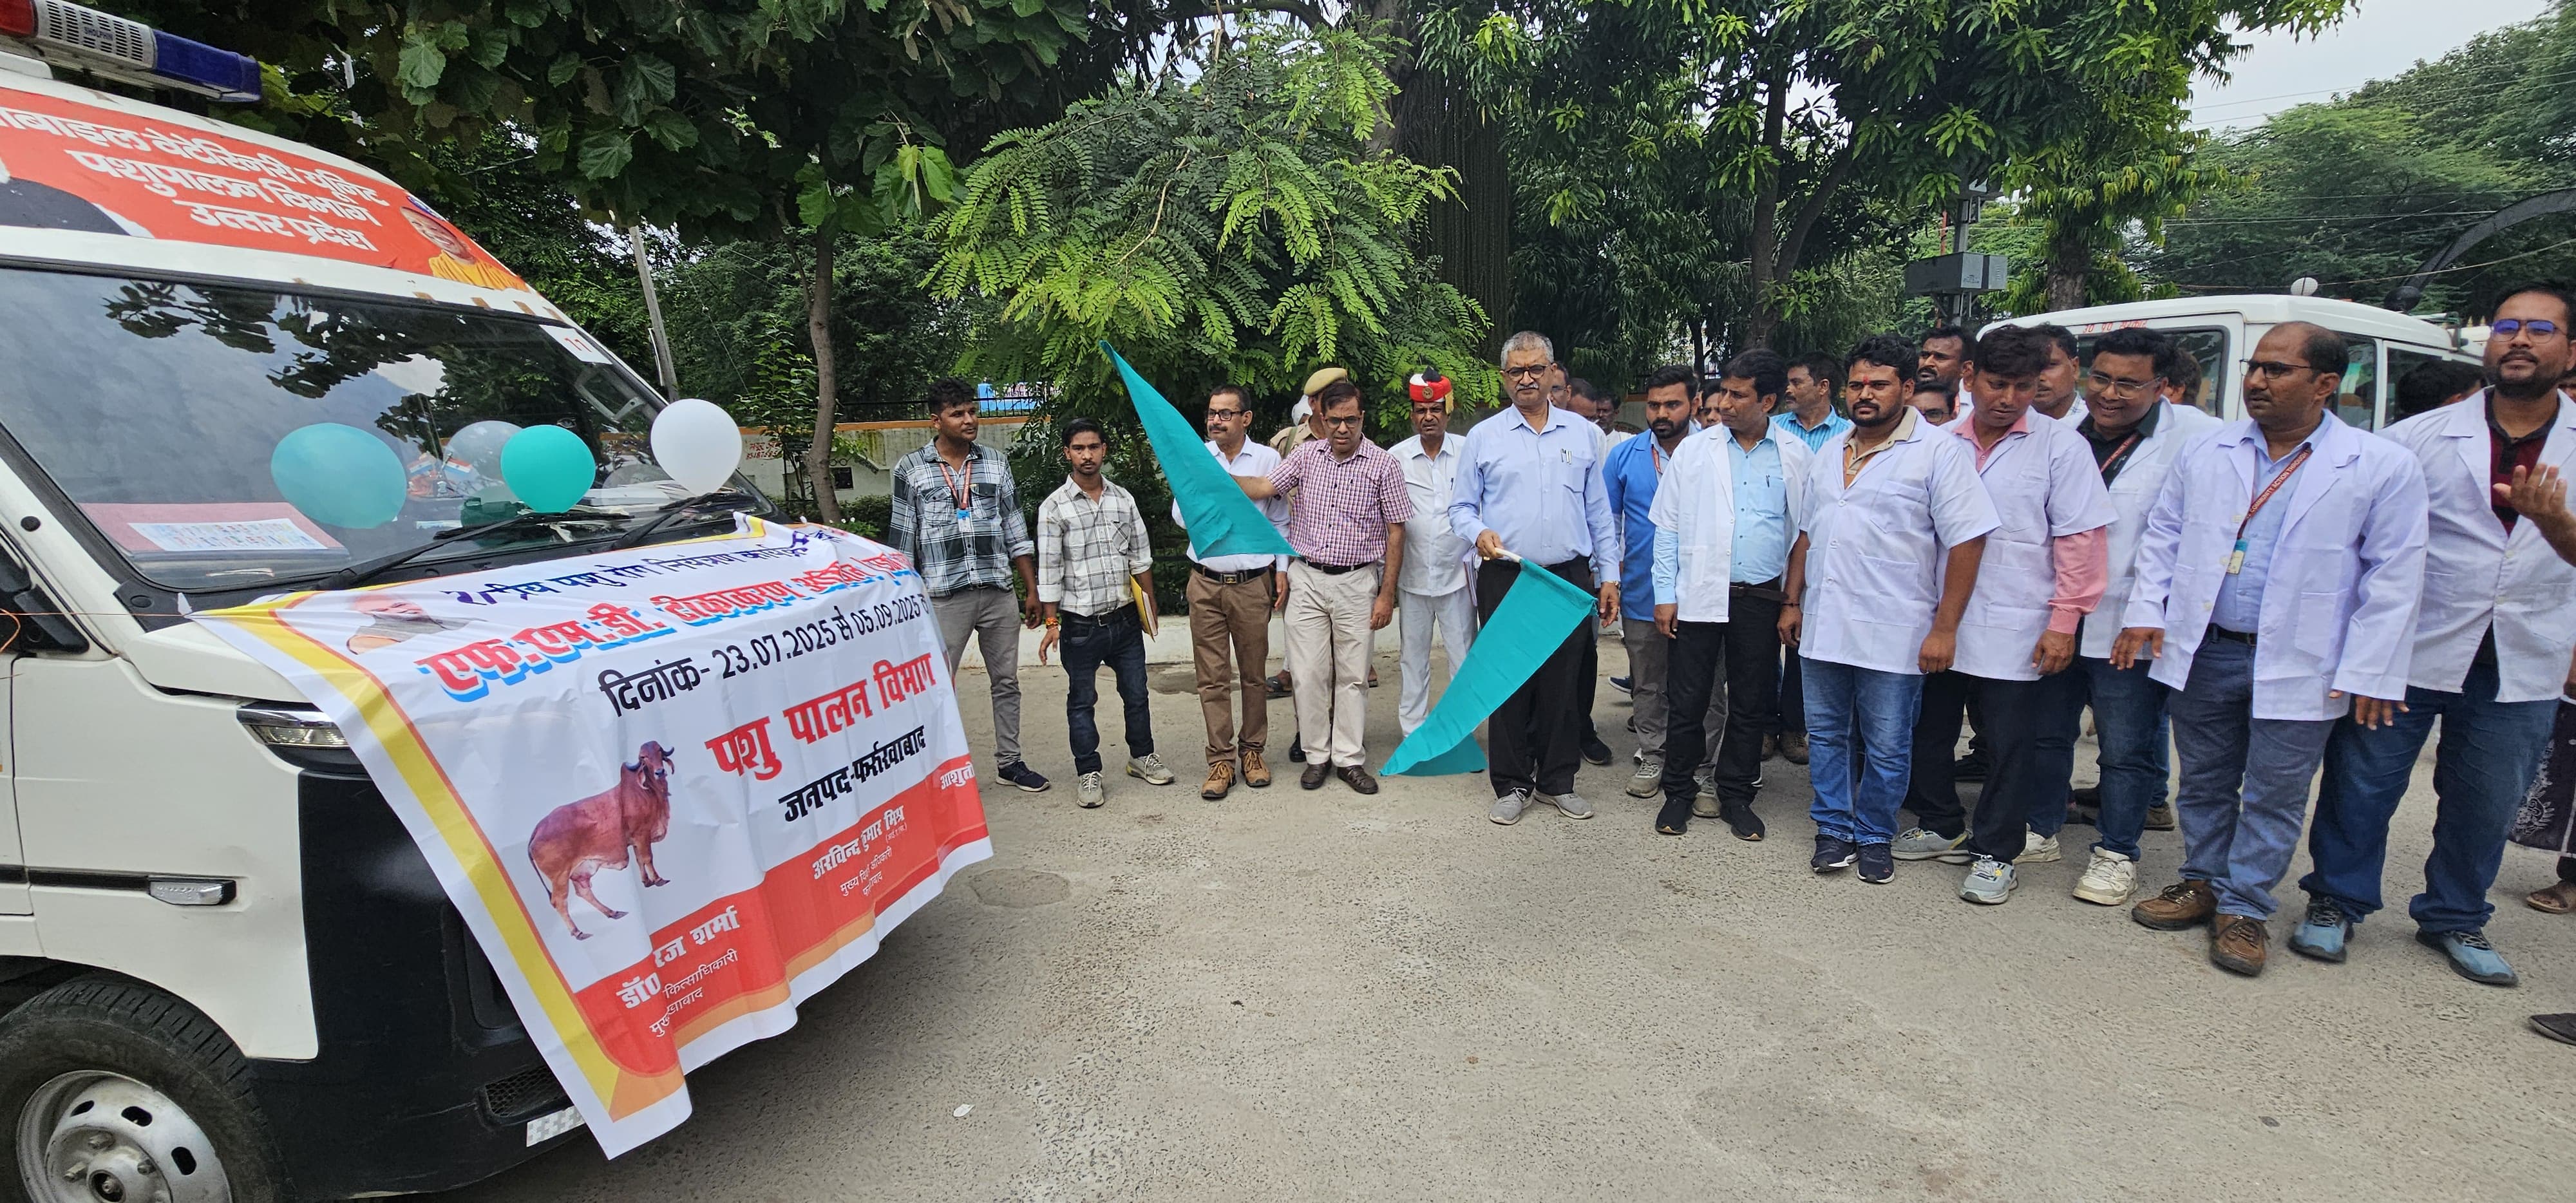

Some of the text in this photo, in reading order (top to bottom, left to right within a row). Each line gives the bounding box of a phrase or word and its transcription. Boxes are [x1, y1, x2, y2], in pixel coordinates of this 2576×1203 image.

[64, 149, 383, 227] पशुपालन विभाग
[294, 167, 390, 206] यूनिट
[172, 199, 380, 252] उत्तर प्रदेश
[2249, 451, 2309, 513] COMMUNITY ACTION THROUGH
[413, 602, 672, 696] एफ.एम.डी.
[649, 580, 806, 623] टीकाकरण
[712, 619, 836, 679] 23.07.2025
[833, 605, 852, 641] से
[851, 594, 922, 636] 05.09.2025
[705, 652, 936, 781] पशु पालन विभाग
[940, 761, 975, 790] आशुतो
[811, 837, 862, 880] अरविन्द
[883, 805, 905, 830] मिश्र
[840, 876, 859, 896] मुख्य
[689, 905, 741, 945] शर्मा
